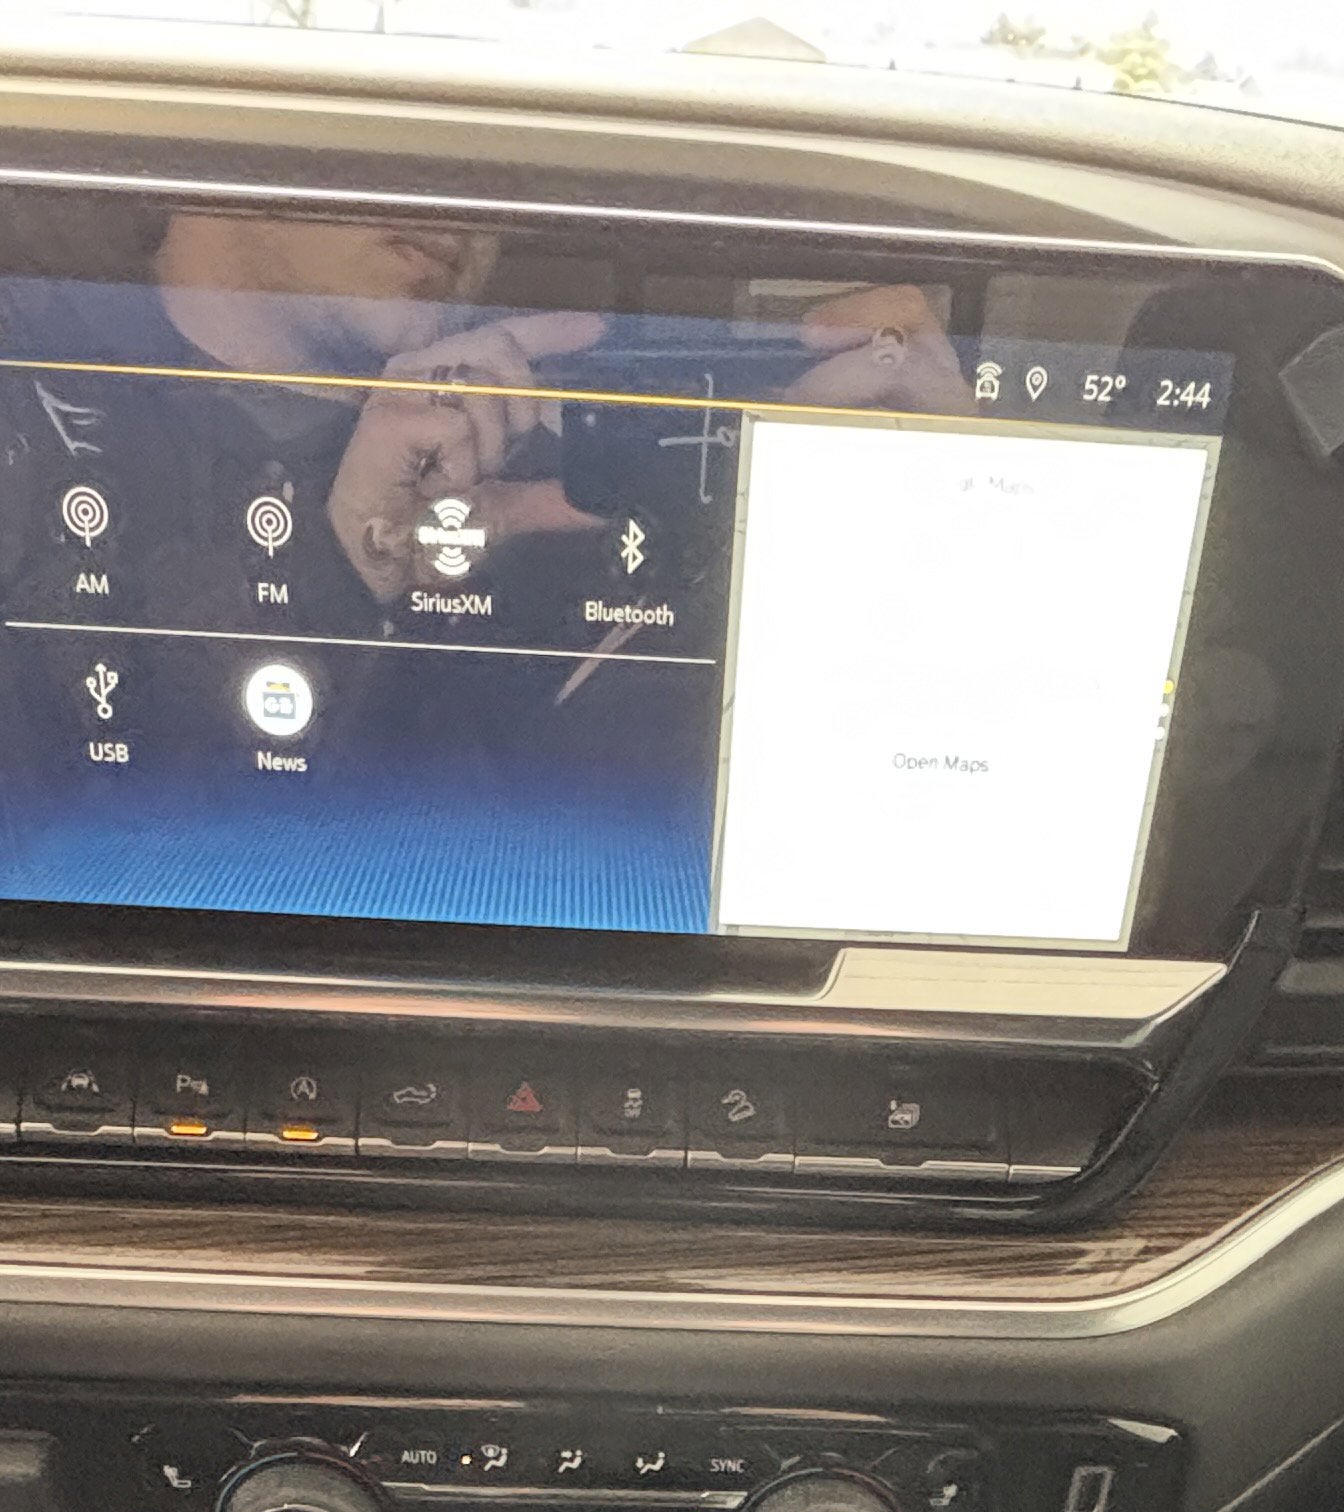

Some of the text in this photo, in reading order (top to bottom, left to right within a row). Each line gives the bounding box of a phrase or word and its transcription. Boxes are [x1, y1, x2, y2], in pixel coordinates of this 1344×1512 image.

[1156, 379, 1212, 409] 2:44
[76, 573, 110, 594] AM
[257, 582, 289, 604] FM
[411, 591, 492, 615] SiriusXM
[585, 600, 674, 626] Bluetooth
[89, 741, 130, 763] USB
[257, 750, 308, 772] News
[892, 752, 990, 776] Open Maps
[401, 1450, 437, 1465] AUTO
[710, 1458, 745, 1473] SYNC
